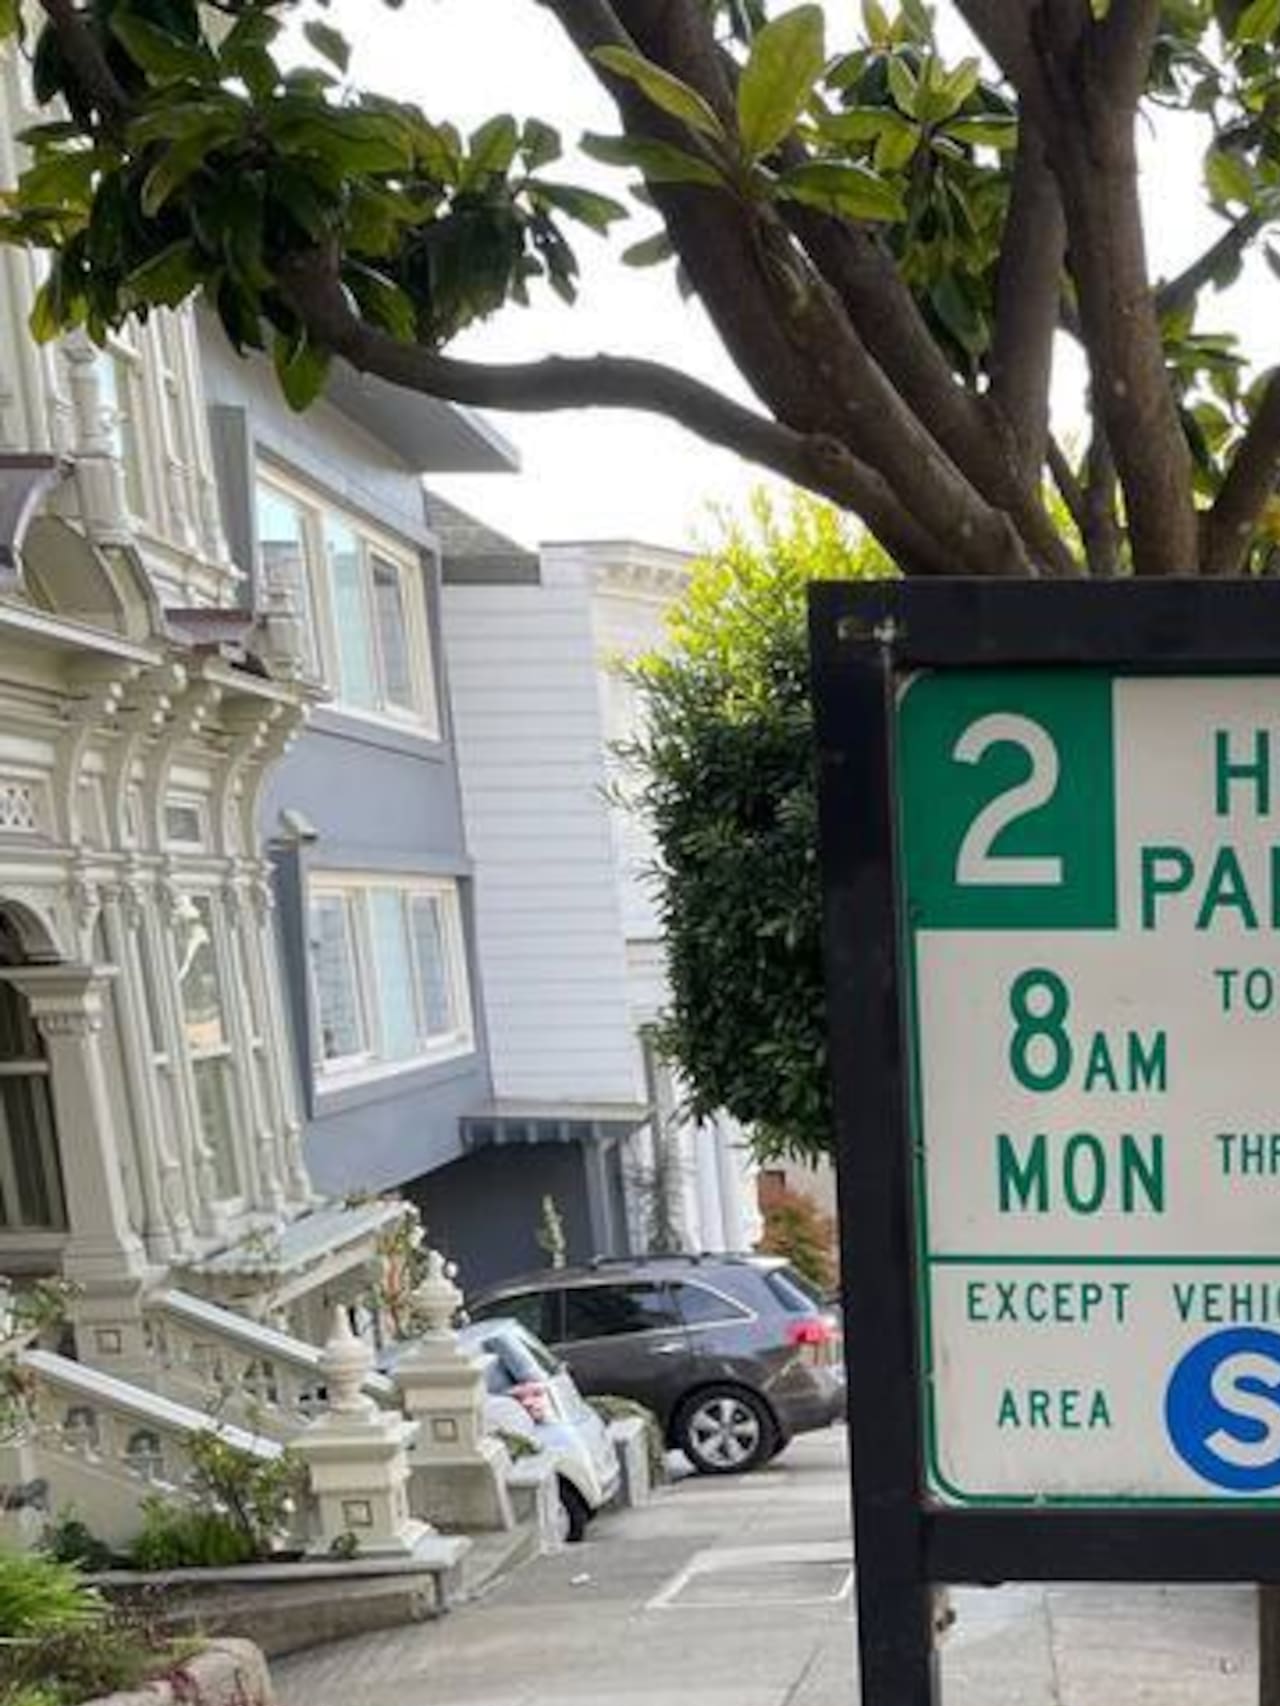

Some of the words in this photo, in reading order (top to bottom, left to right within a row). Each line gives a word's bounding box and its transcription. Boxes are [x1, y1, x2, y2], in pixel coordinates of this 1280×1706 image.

[954, 713, 1063, 886] 2
[1214, 968, 1273, 1012] TO
[997, 1133, 1164, 1214] MON
[967, 1281, 1131, 1323] EXCEPT
[998, 1389, 1112, 1429] AREA
